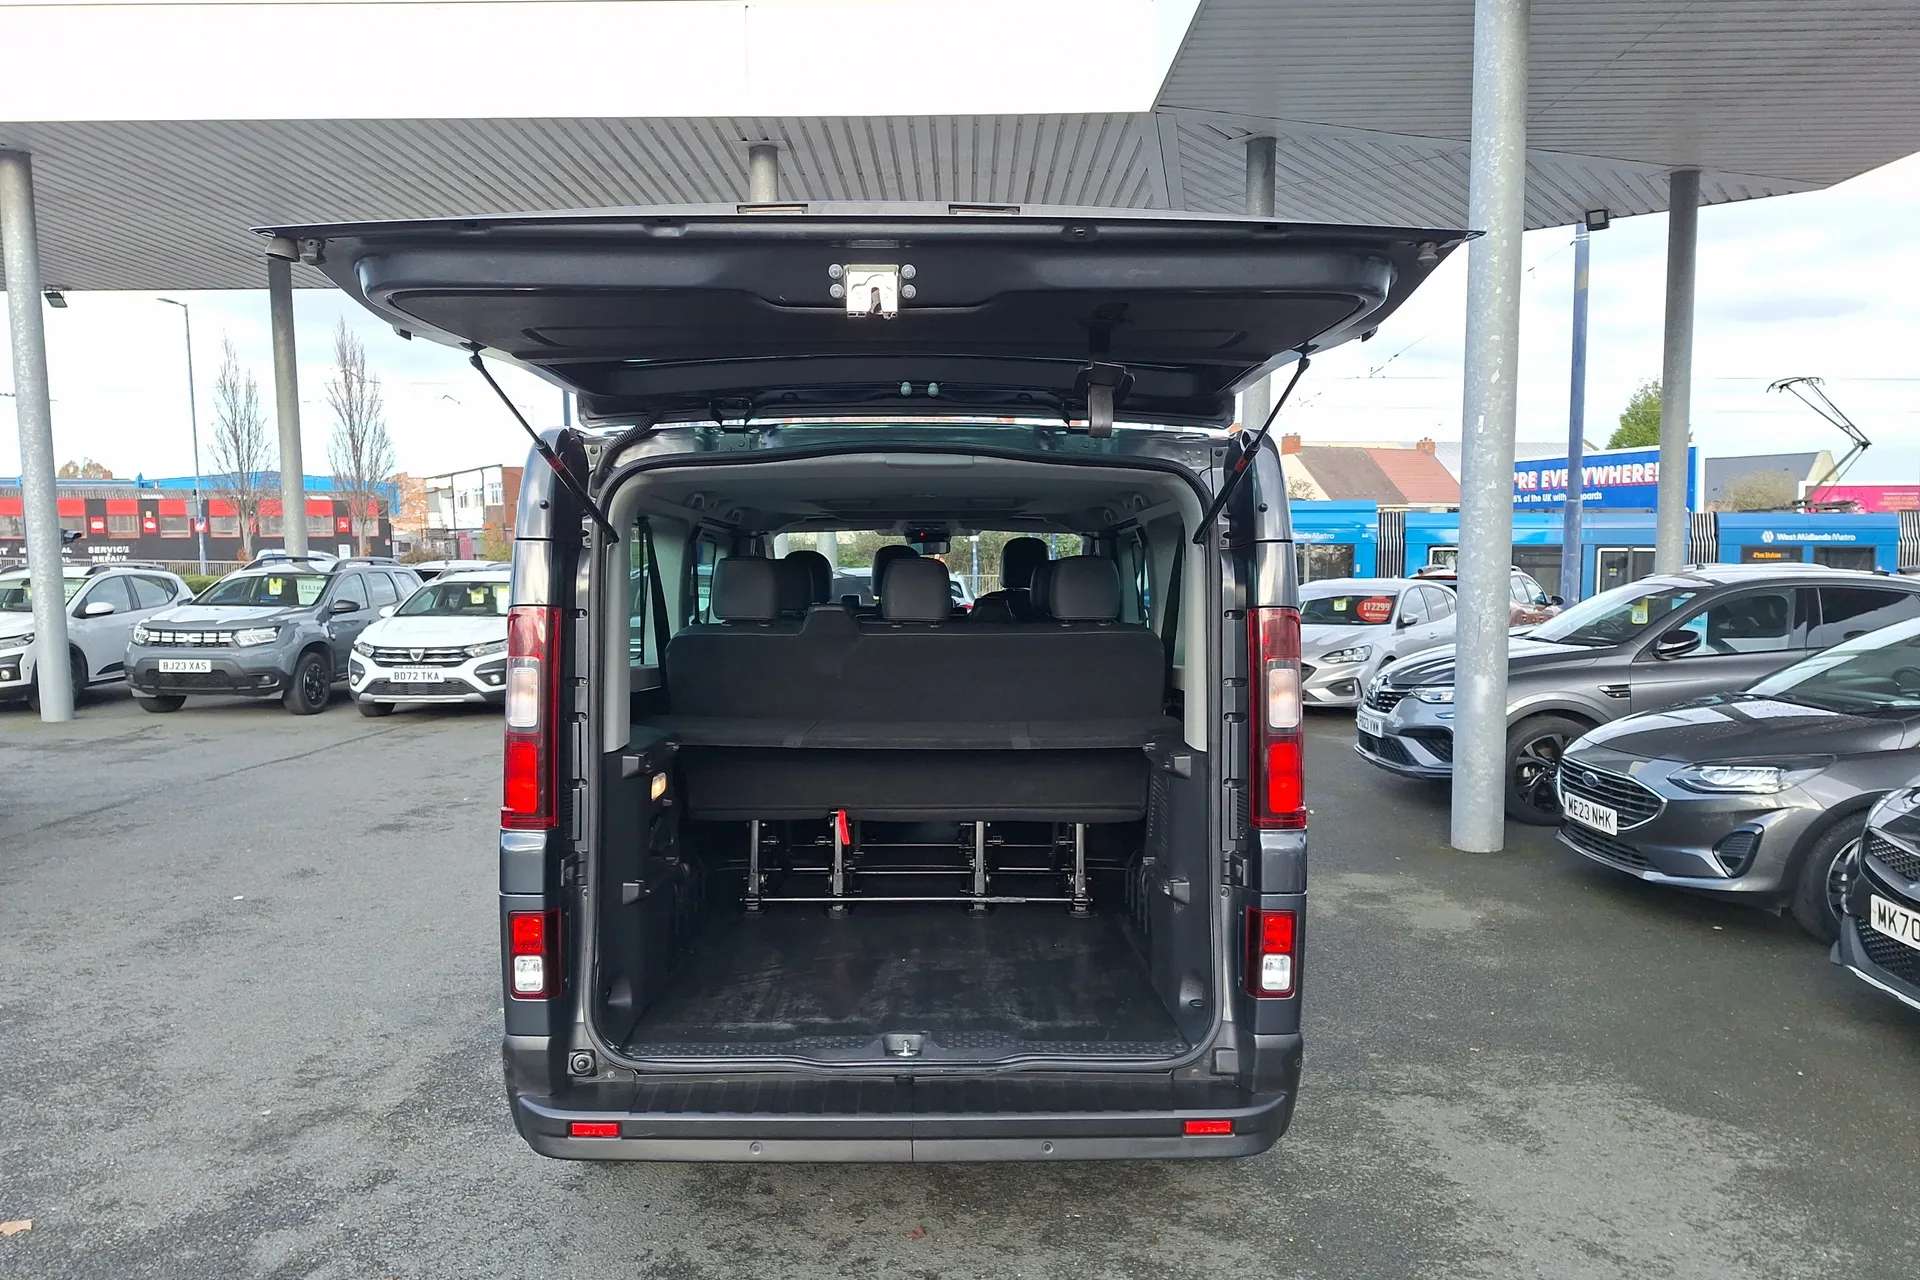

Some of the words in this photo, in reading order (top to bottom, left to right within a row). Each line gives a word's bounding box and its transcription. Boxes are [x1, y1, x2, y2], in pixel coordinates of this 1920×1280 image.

[1541, 462, 1660, 491] EVEYWHERE!
[1776, 533, 1796, 541] West
[1797, 533, 1832, 541] Midlands
[1832, 533, 1856, 541] Metro
[162, 661, 187, 670] BJ23
[189, 661, 207, 670] XAS
[420, 671, 440, 681] TKA
[1592, 806, 1612, 830] NHK
